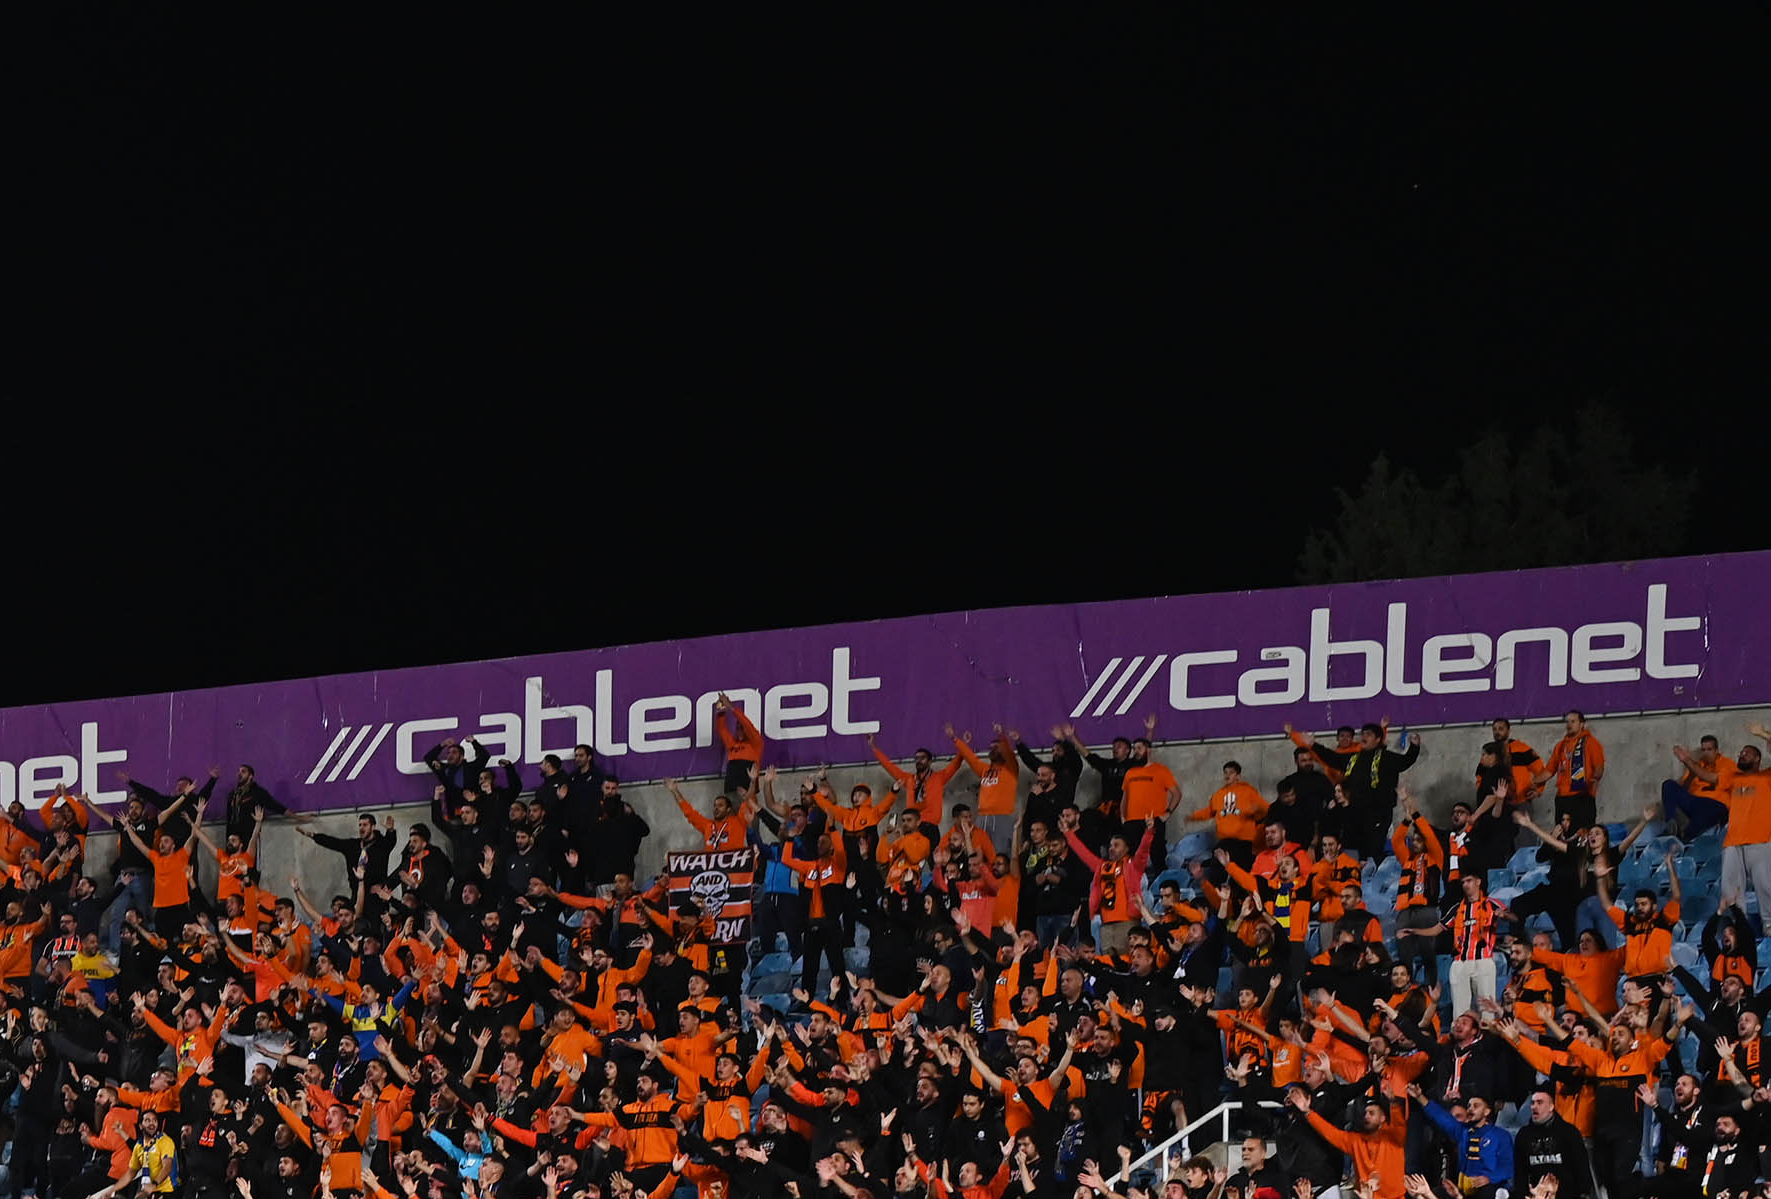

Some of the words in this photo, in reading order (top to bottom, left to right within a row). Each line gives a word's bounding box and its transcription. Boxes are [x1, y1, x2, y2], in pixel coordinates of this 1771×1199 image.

[1168, 583, 1701, 711] cablenet
[395, 646, 882, 775] cablenet
[669, 848, 752, 873] WATCH
[696, 873, 722, 886] AND
[81, 968, 100, 976] POEL
